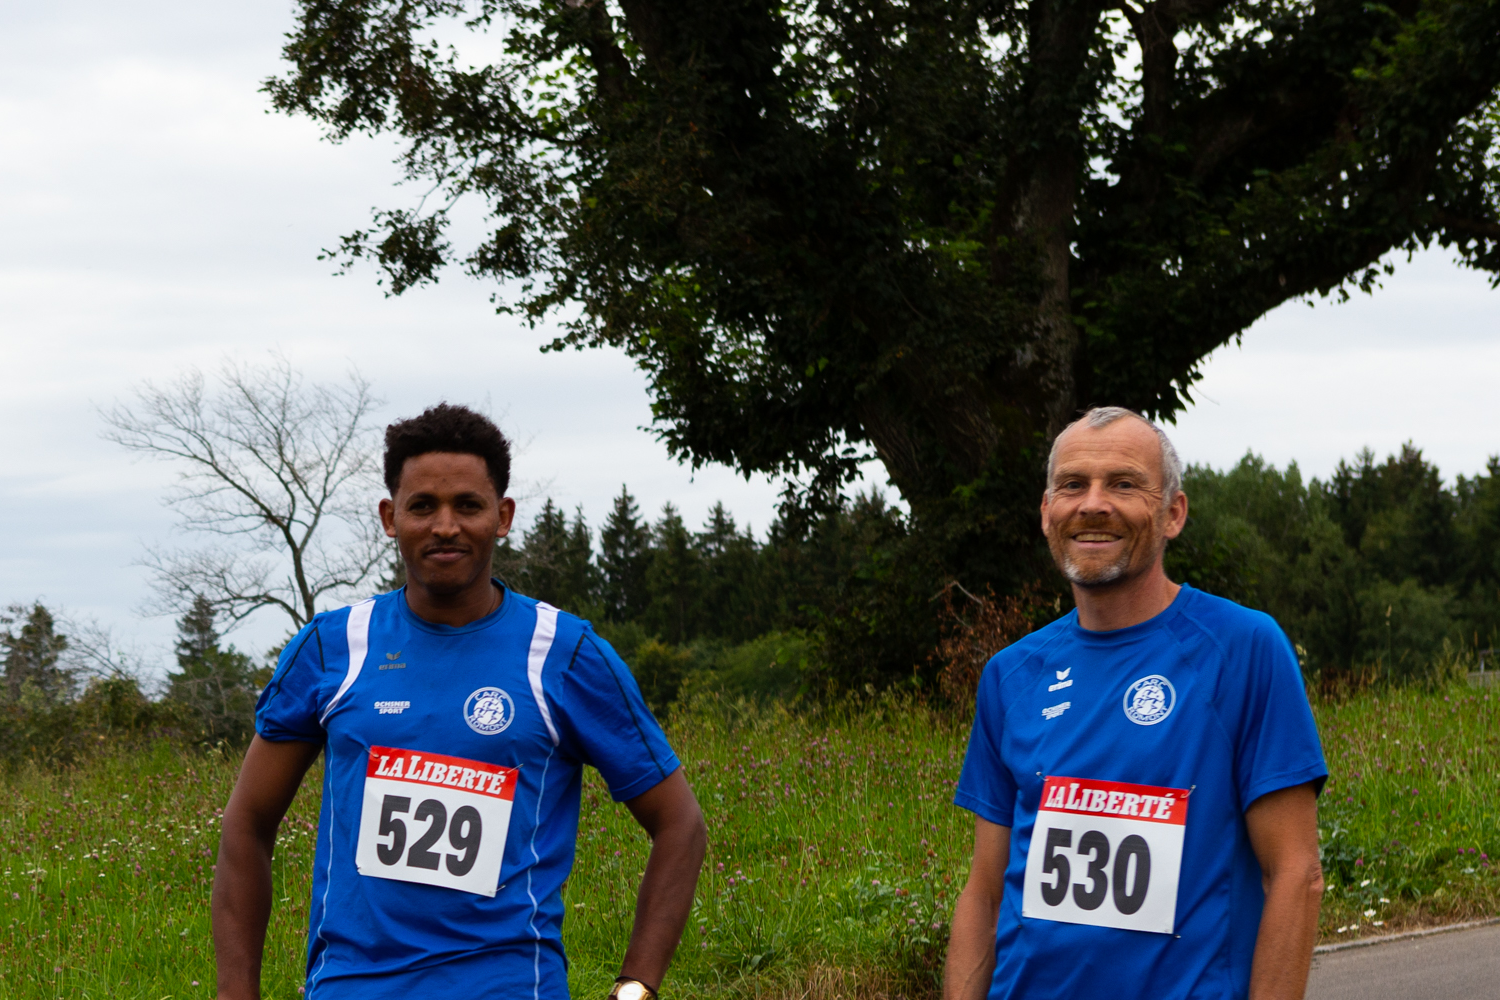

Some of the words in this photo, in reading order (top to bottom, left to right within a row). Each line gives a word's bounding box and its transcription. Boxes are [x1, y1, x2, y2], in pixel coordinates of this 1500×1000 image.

[475, 691, 506, 702] CARC
[1134, 679, 1165, 691] CARC
[377, 794, 482, 877] 529
[1041, 827, 1151, 915] 530
